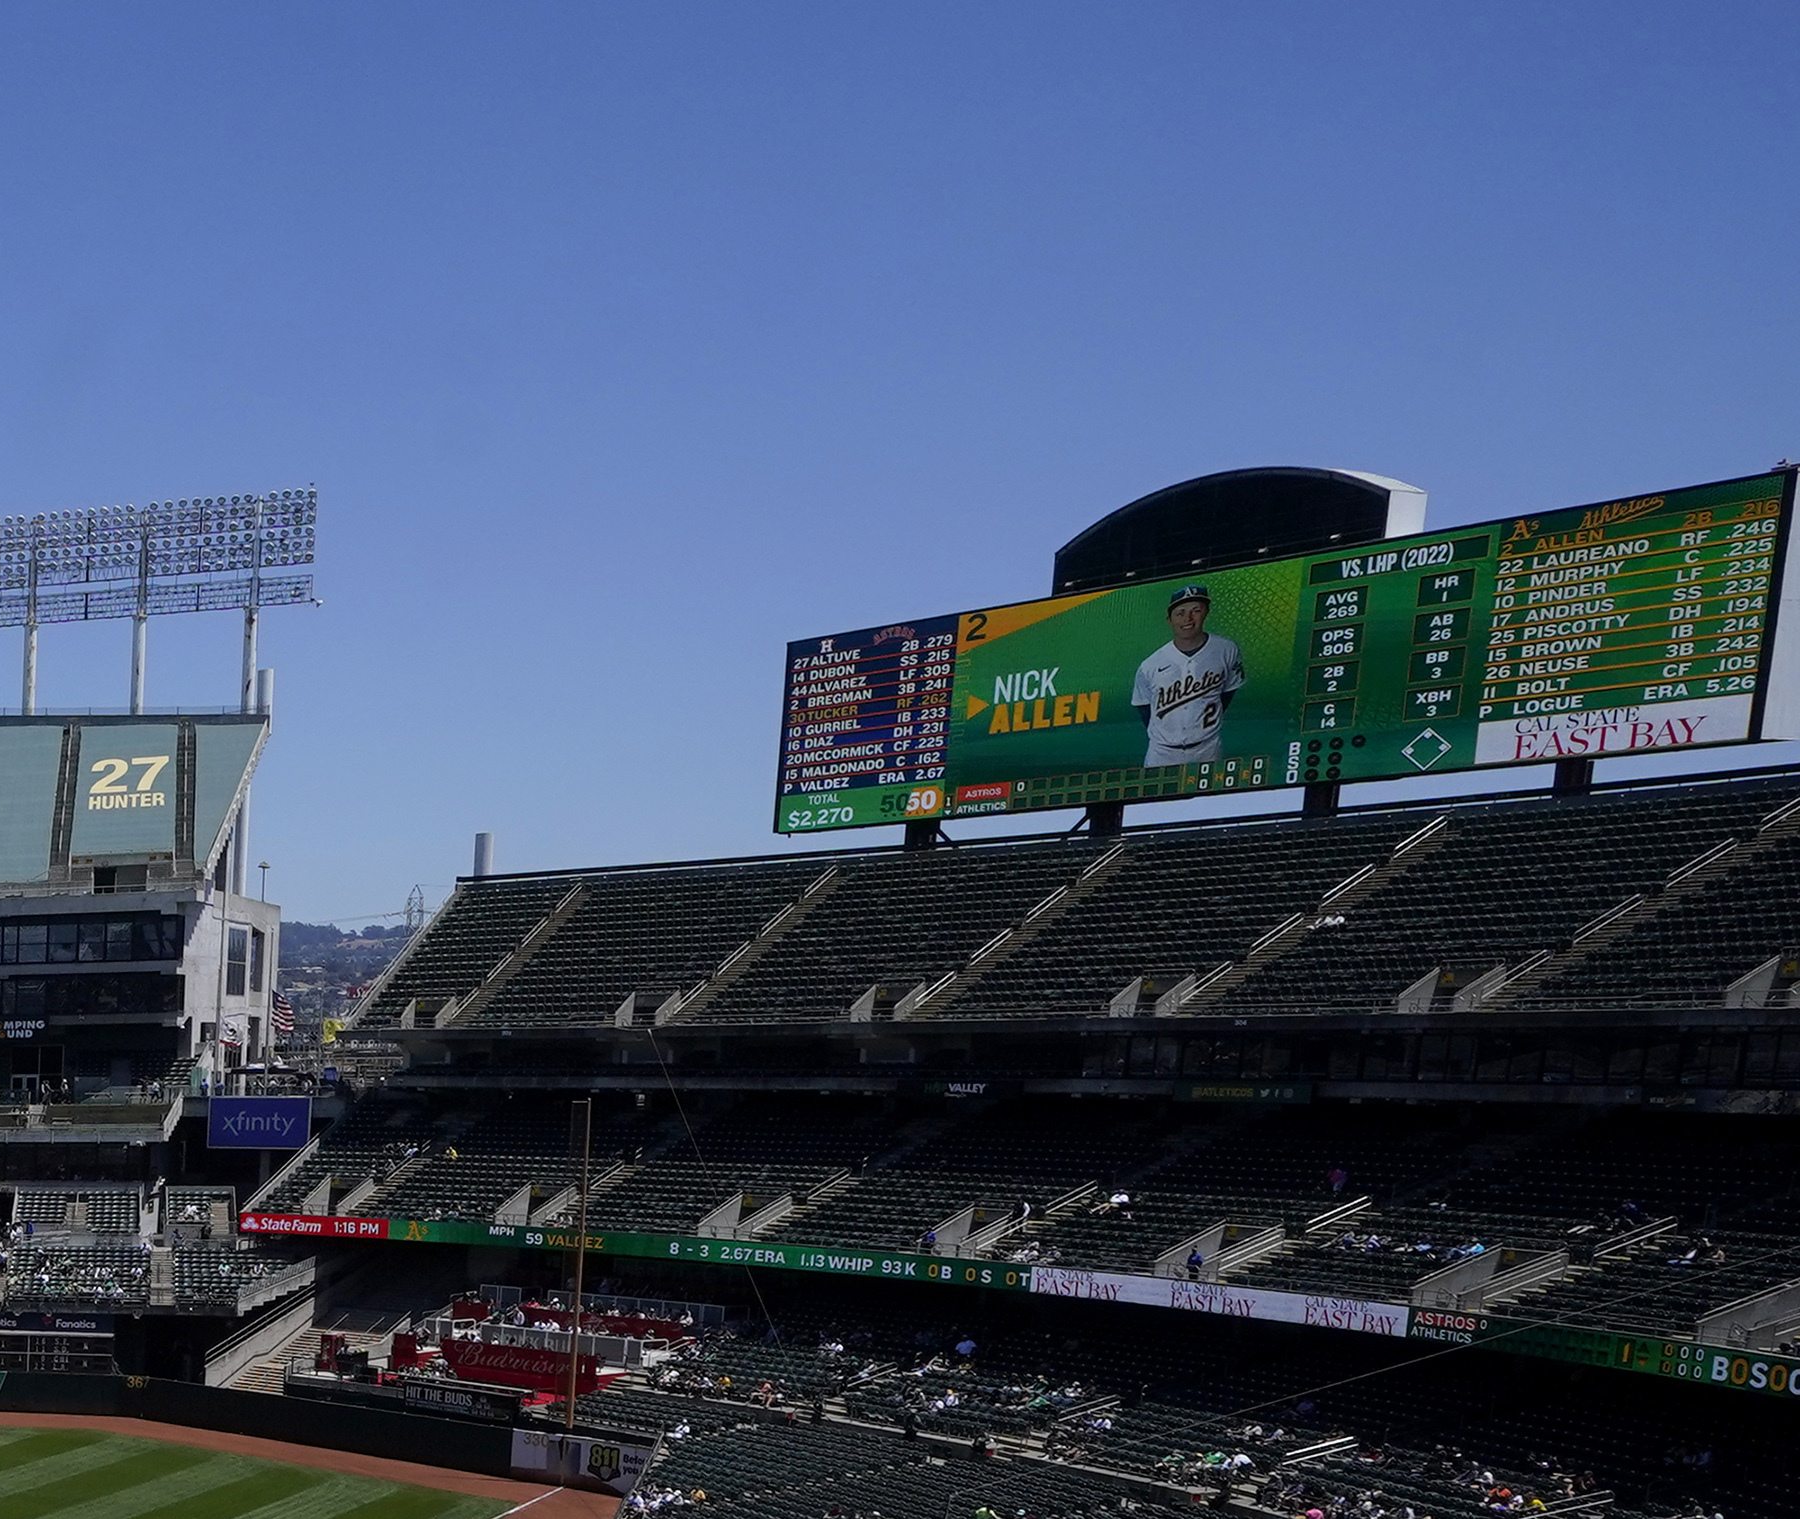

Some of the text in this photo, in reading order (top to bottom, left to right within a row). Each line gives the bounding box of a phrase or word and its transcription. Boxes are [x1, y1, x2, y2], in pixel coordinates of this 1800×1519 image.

[1531, 518, 1777, 570] LAUREANO .246
[1535, 528, 1605, 549] ALLEN
[1341, 541, 1455, 579] VS. LHP (2022)
[1529, 560, 1625, 588] MURPHY
[1325, 591, 1358, 606] AVG
[1527, 581, 1607, 605] PINDER
[1524, 598, 1616, 623] ANDRUS
[1321, 628, 1354, 643] OPS
[1523, 612, 1631, 641] PISCOTTY
[1521, 635, 1602, 659] BROWN
[1518, 656, 1590, 677] NEUSE
[993, 667, 1060, 704] NICK
[1512, 674, 1757, 716] LOGUE ERA 5.26
[1516, 677, 1571, 696] BOLT
[1416, 690, 1452, 704] XBH
[988, 691, 1100, 735] ALLEN
[1515, 706, 1641, 735] CAL STATE
[1514, 715, 1709, 760] EAST BAY
[90, 756, 170, 794] 27
[88, 792, 165, 810] HUNTER
[808, 793, 840, 806] TOTAL
[965, 787, 1001, 798] ASTROS
[788, 807, 854, 828] $2,270
[956, 801, 1006, 815] ATHLETICS
[222, 1107, 296, 1140] xfinity
[333, 1221, 355, 1234] 1:16
[360, 1221, 379, 1235] PM
[489, 1225, 543, 1246] MPH 59
[721, 1246, 785, 1264] 2.67 ERA
[801, 1253, 916, 1277] 1.13 WHIP 93 K
[55, 1318, 97, 1330] Fanatics
[1304, 1308, 1399, 1334] EAST BAY
[1413, 1311, 1475, 1330] ASTROS
[1411, 1326, 1472, 1344] ATHLETICS
[405, 1385, 473, 1407] HIT THE BUDS
[589, 1444, 619, 1468] 811
